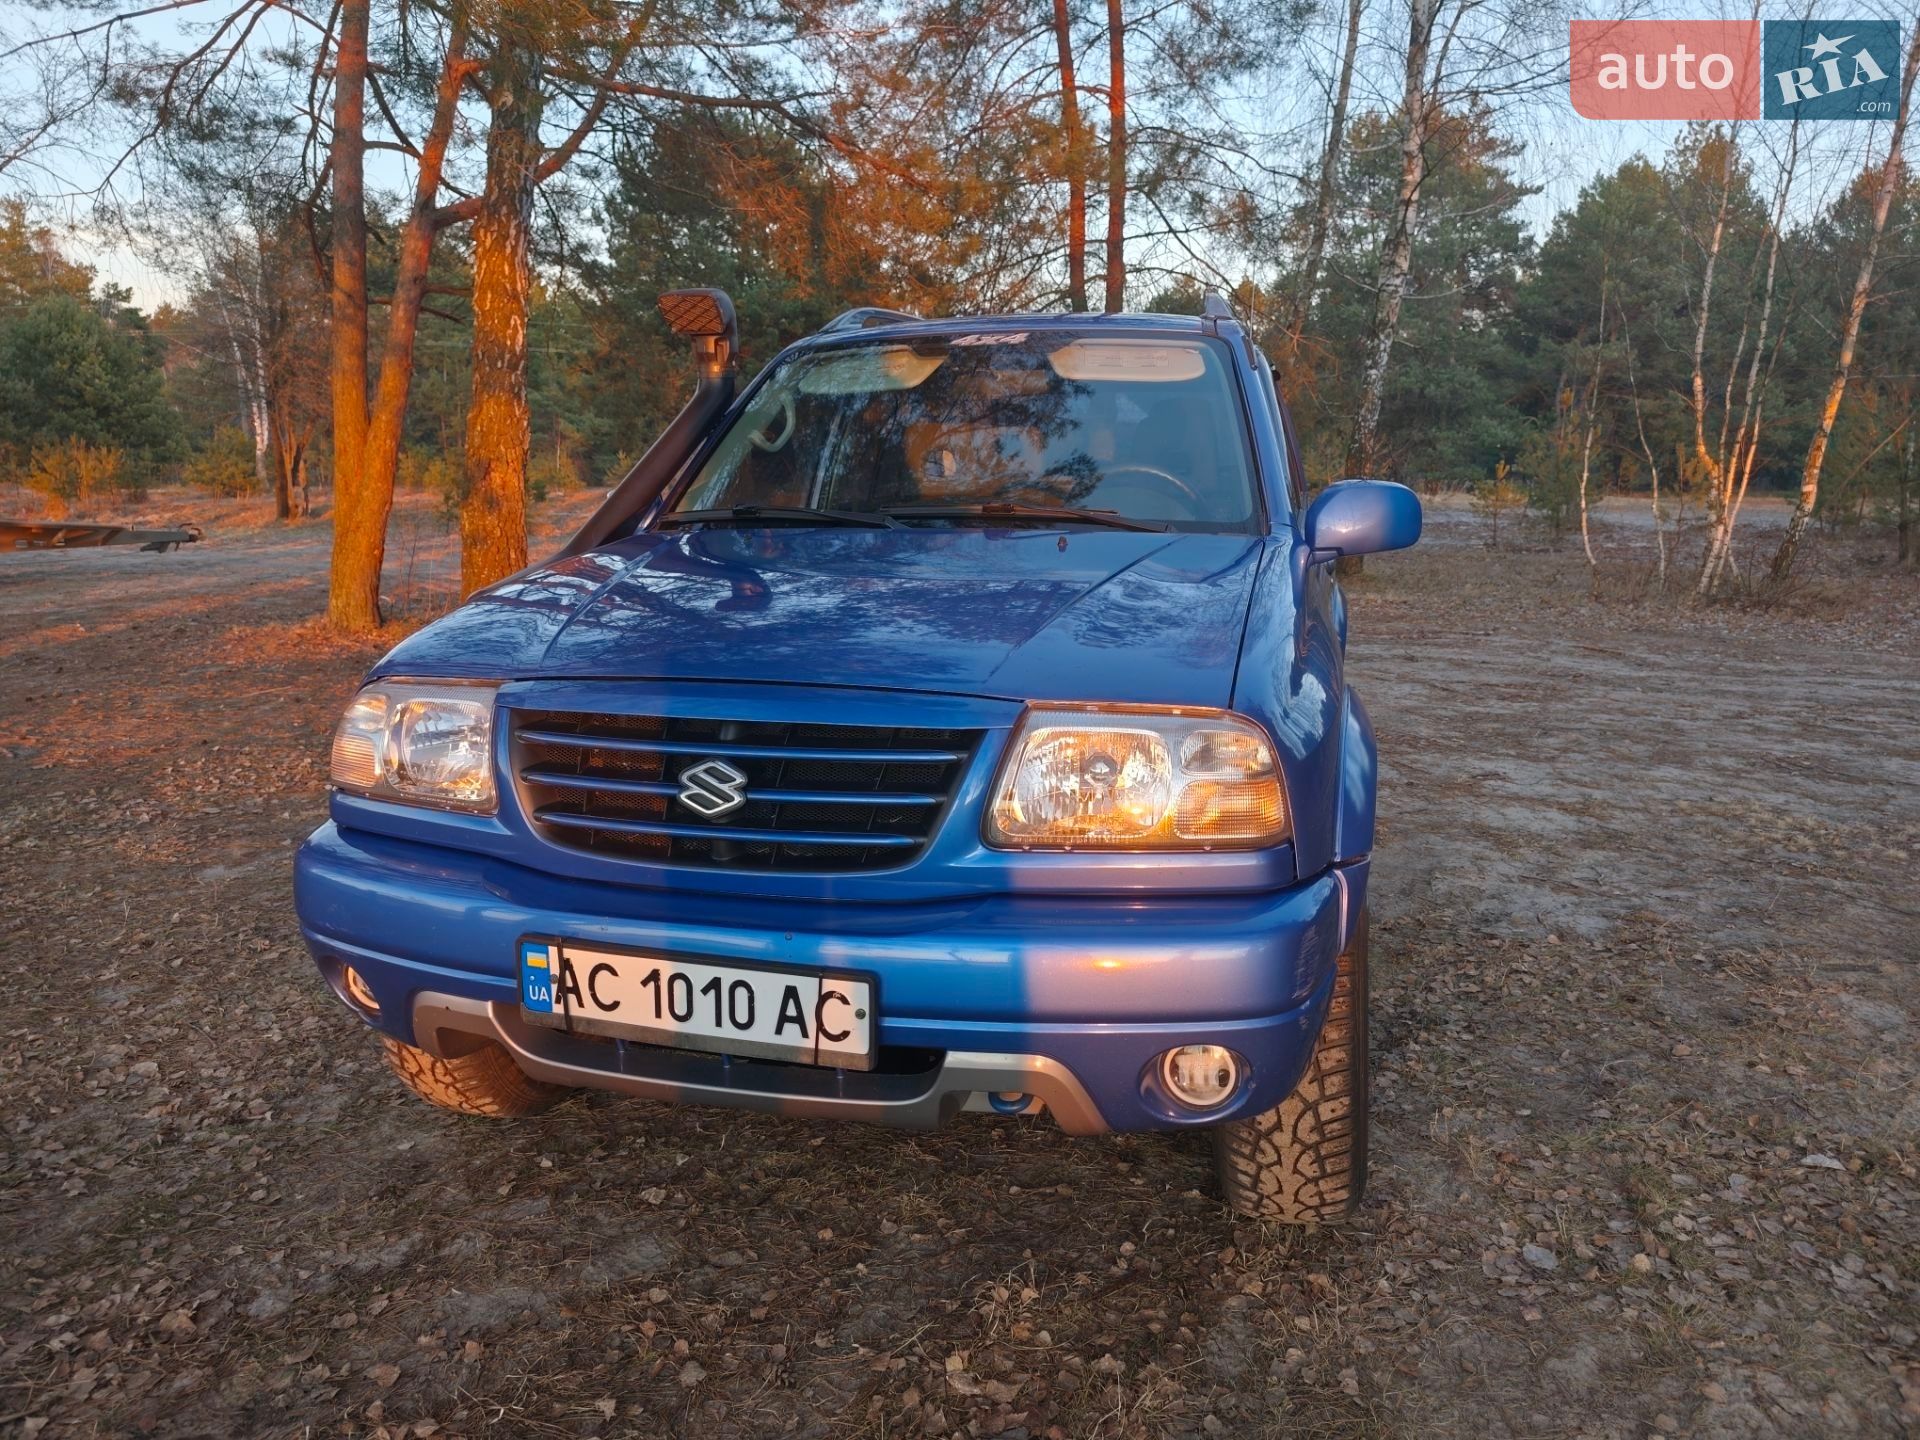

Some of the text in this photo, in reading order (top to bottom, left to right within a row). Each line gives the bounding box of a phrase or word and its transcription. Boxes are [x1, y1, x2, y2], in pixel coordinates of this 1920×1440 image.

[529, 984, 550, 1003] UA
[554, 957, 851, 1042] AC 1010 AC
